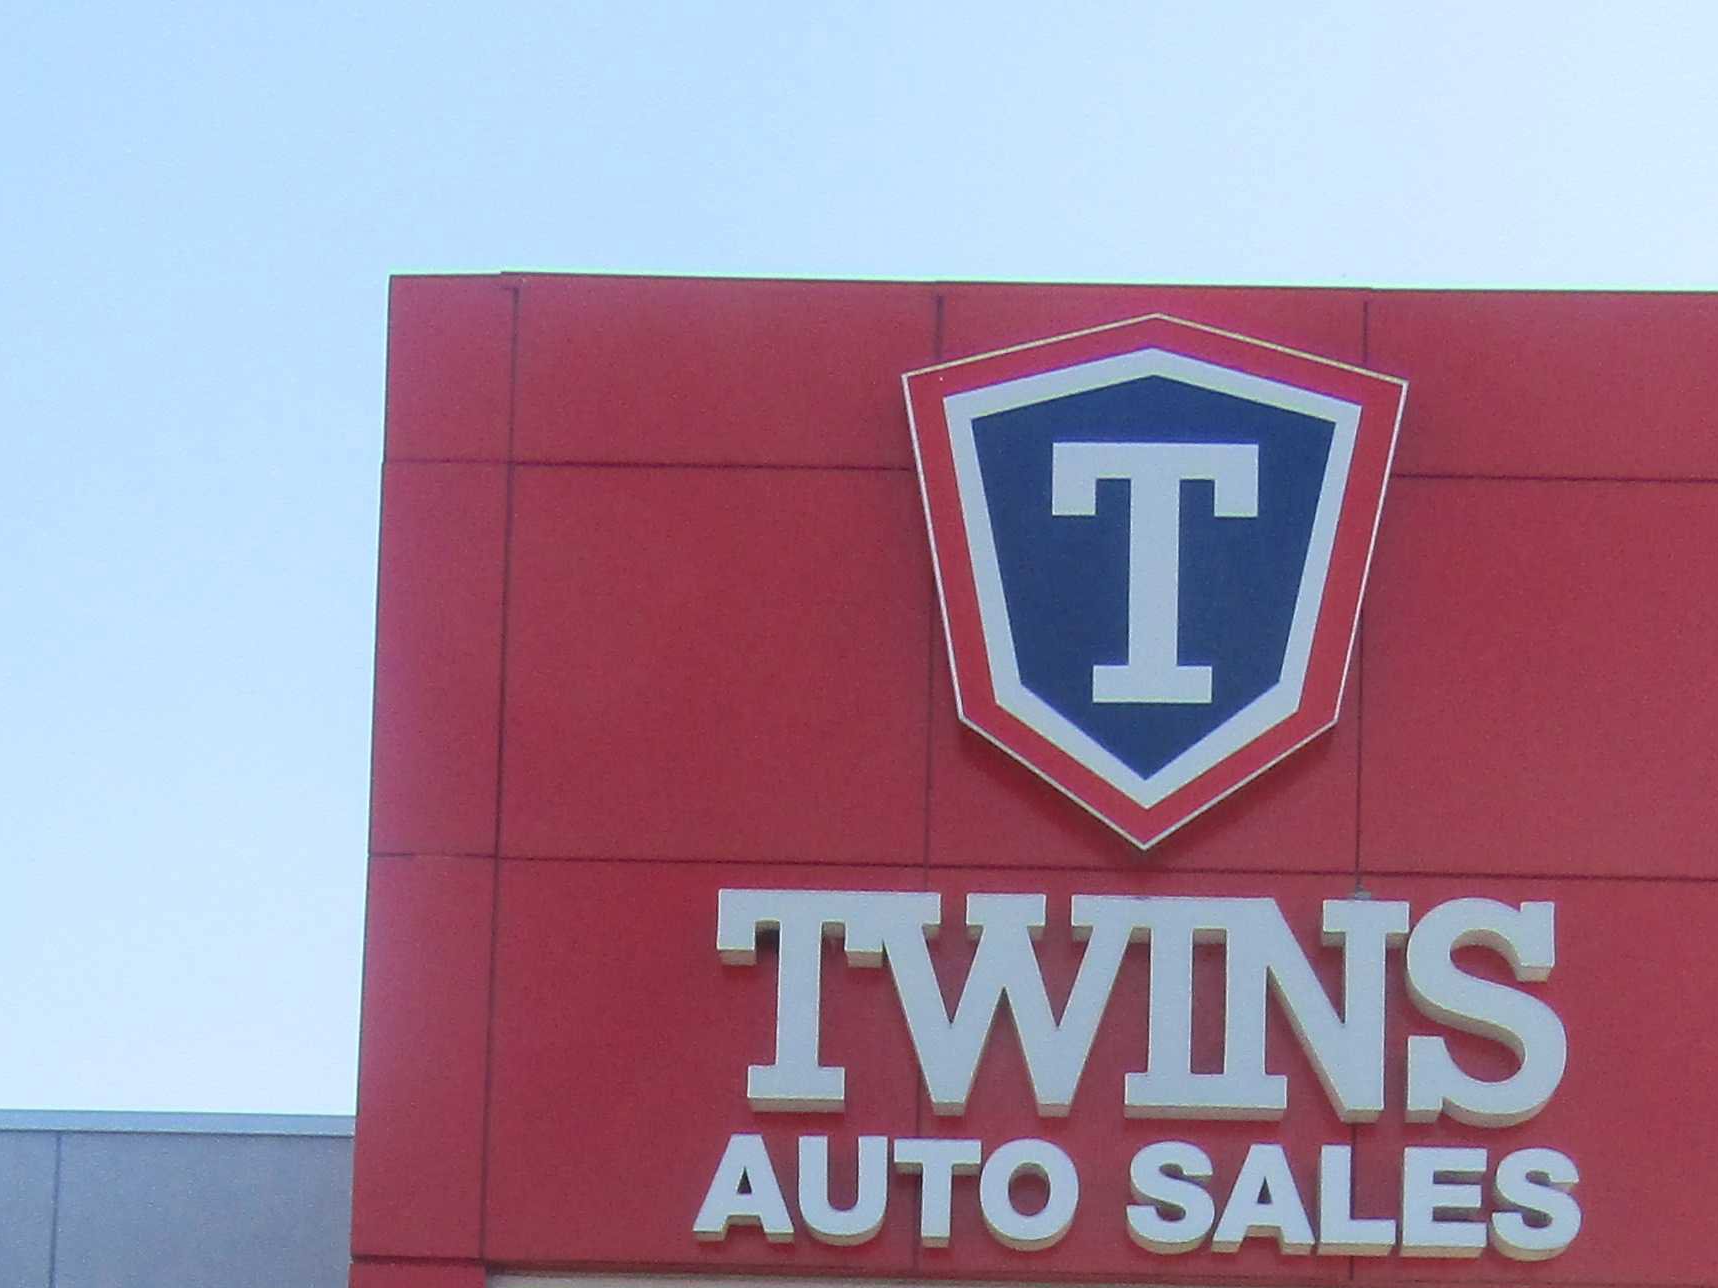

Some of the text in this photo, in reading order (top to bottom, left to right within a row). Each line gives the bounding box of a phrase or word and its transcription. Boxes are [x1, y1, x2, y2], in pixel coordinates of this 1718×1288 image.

[1051, 442, 1259, 705] T
[717, 888, 1569, 1129] TWINS
[691, 1133, 1582, 1263] AUTO SALES
